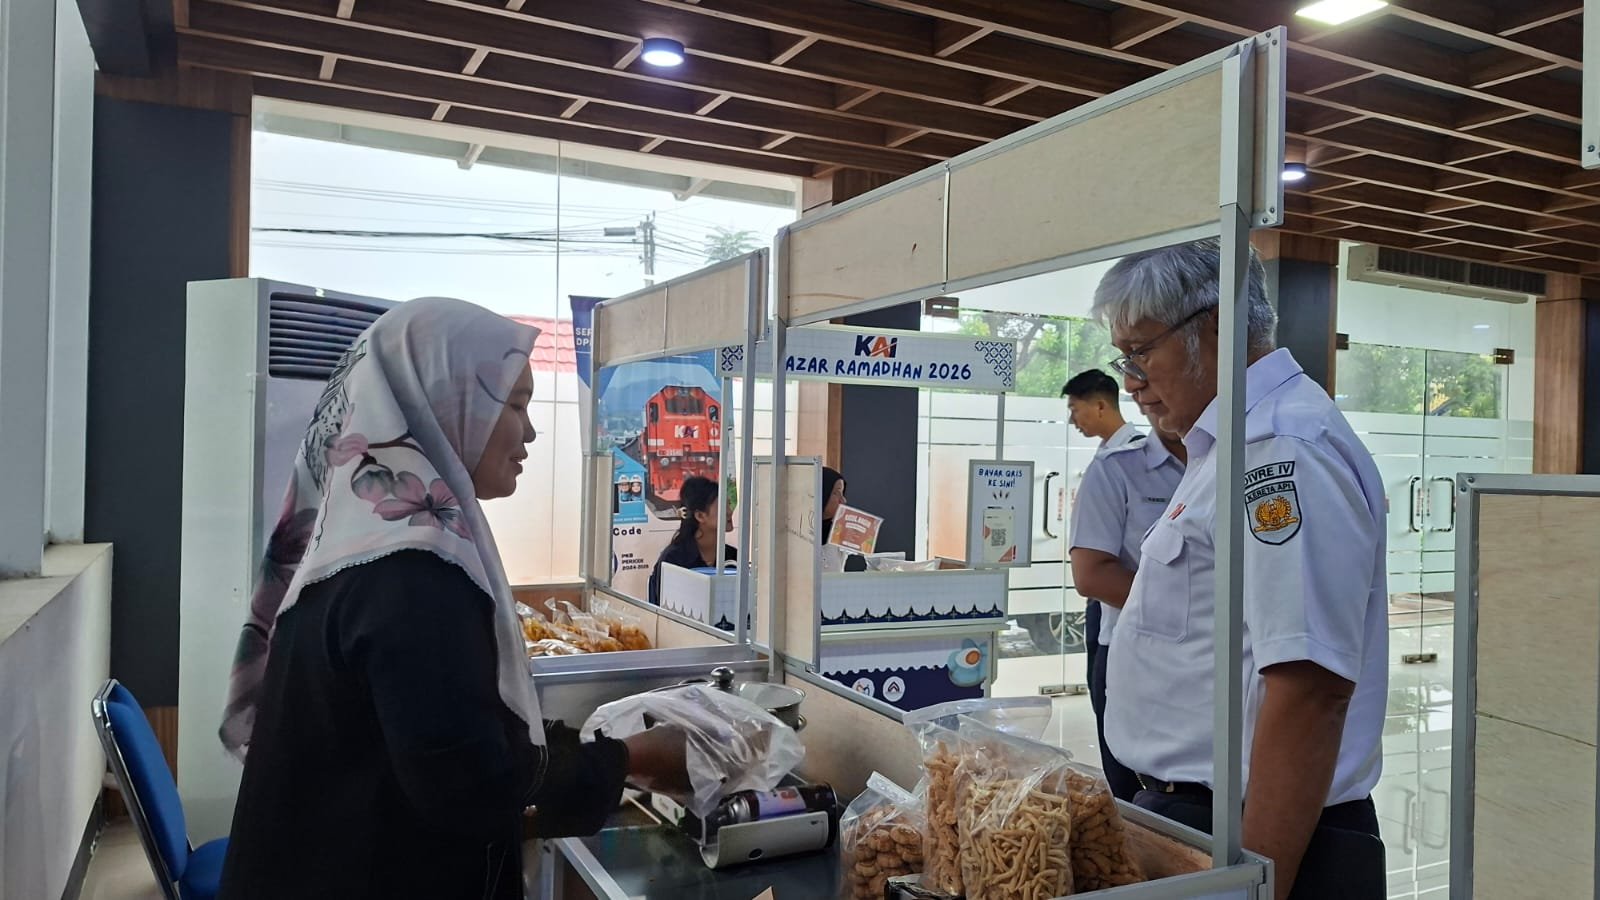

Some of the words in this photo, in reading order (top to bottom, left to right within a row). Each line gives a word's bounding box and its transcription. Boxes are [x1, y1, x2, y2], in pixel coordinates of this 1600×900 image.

[854, 334, 898, 358] KAI
[784, 356, 829, 373] AZAR
[835, 359, 923, 380] RAMADHAN
[929, 362, 972, 381] 2026
[978, 468, 1003, 477] BAYAR
[1005, 470, 1023, 478] QRIS
[1278, 464, 1290, 474] IV
[988, 478, 997, 486] KE
[1247, 486, 1276, 501] KERETA
[1278, 483, 1291, 491] API
[613, 526, 642, 536] Code
